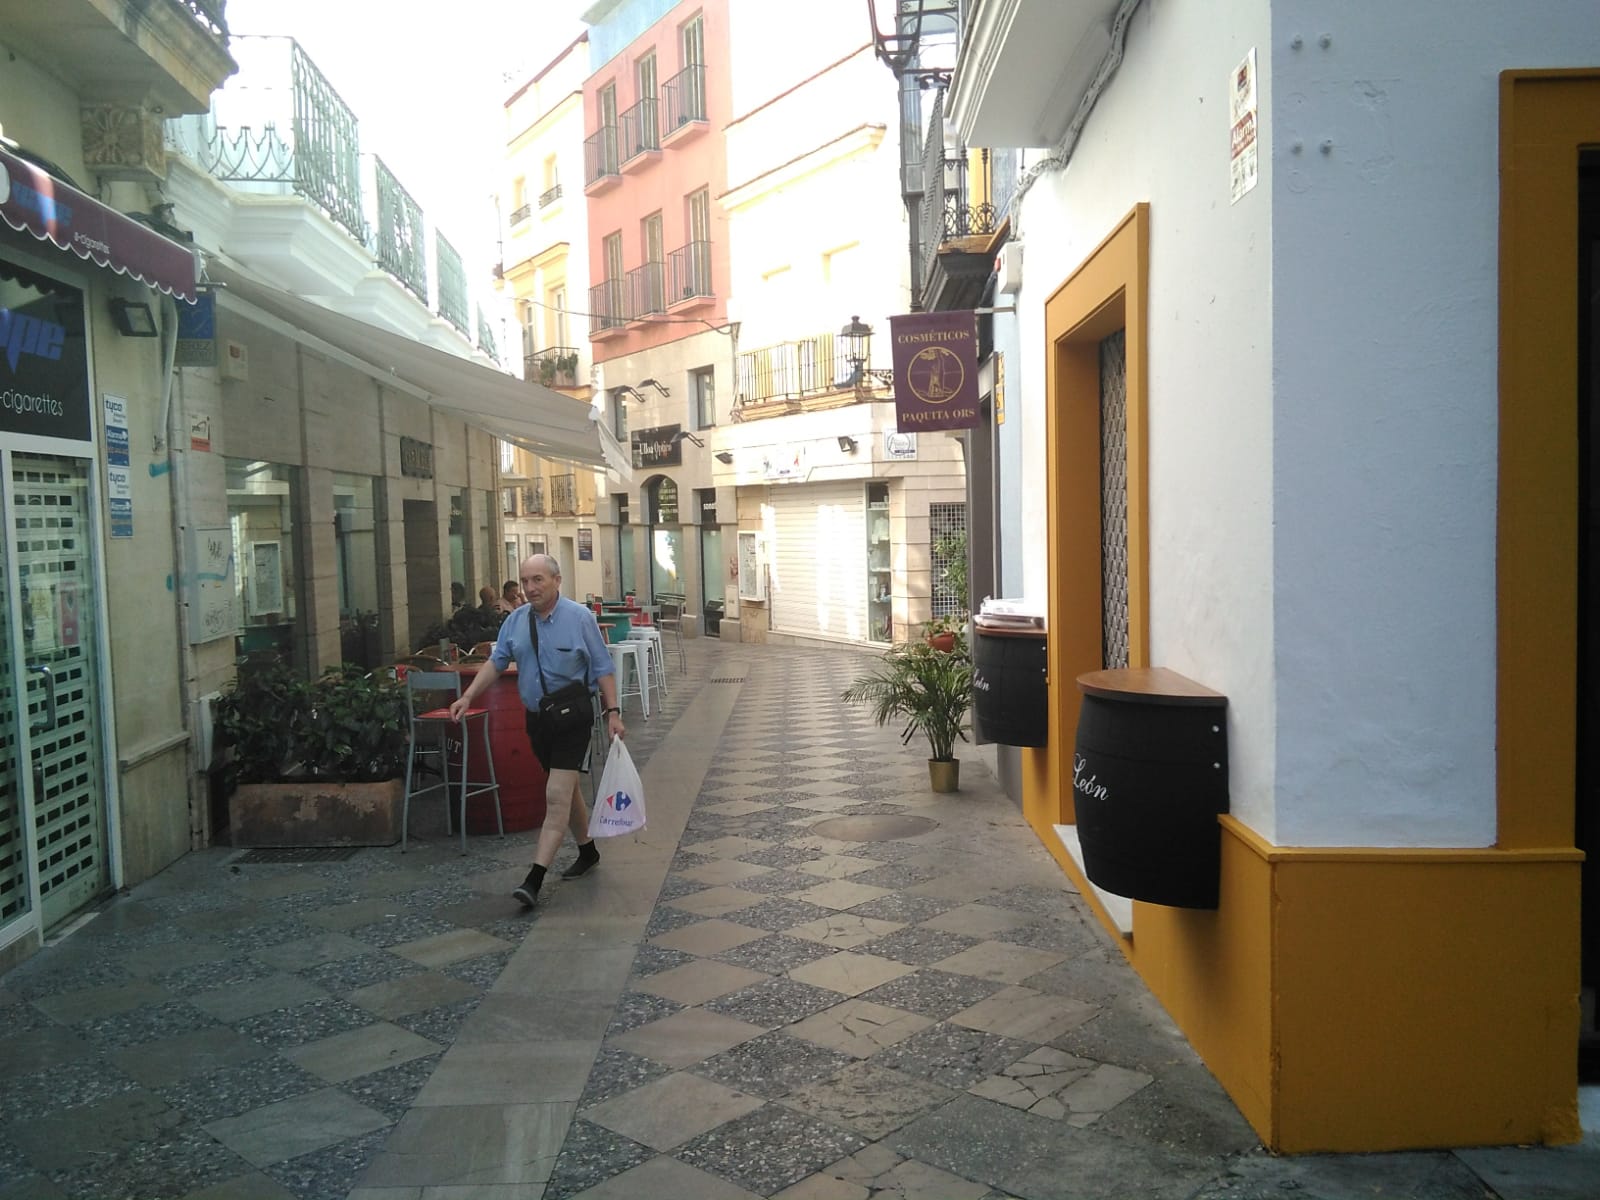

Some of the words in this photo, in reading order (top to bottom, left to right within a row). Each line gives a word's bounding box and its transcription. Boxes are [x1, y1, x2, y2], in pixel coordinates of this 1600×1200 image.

[898, 329, 970, 344] COSMÉTICOS
[106, 400, 123, 412] tyco
[902, 410, 950, 423] PAQUITA
[952, 408, 975, 418] ORS
[1073, 752, 1110, 801] León
